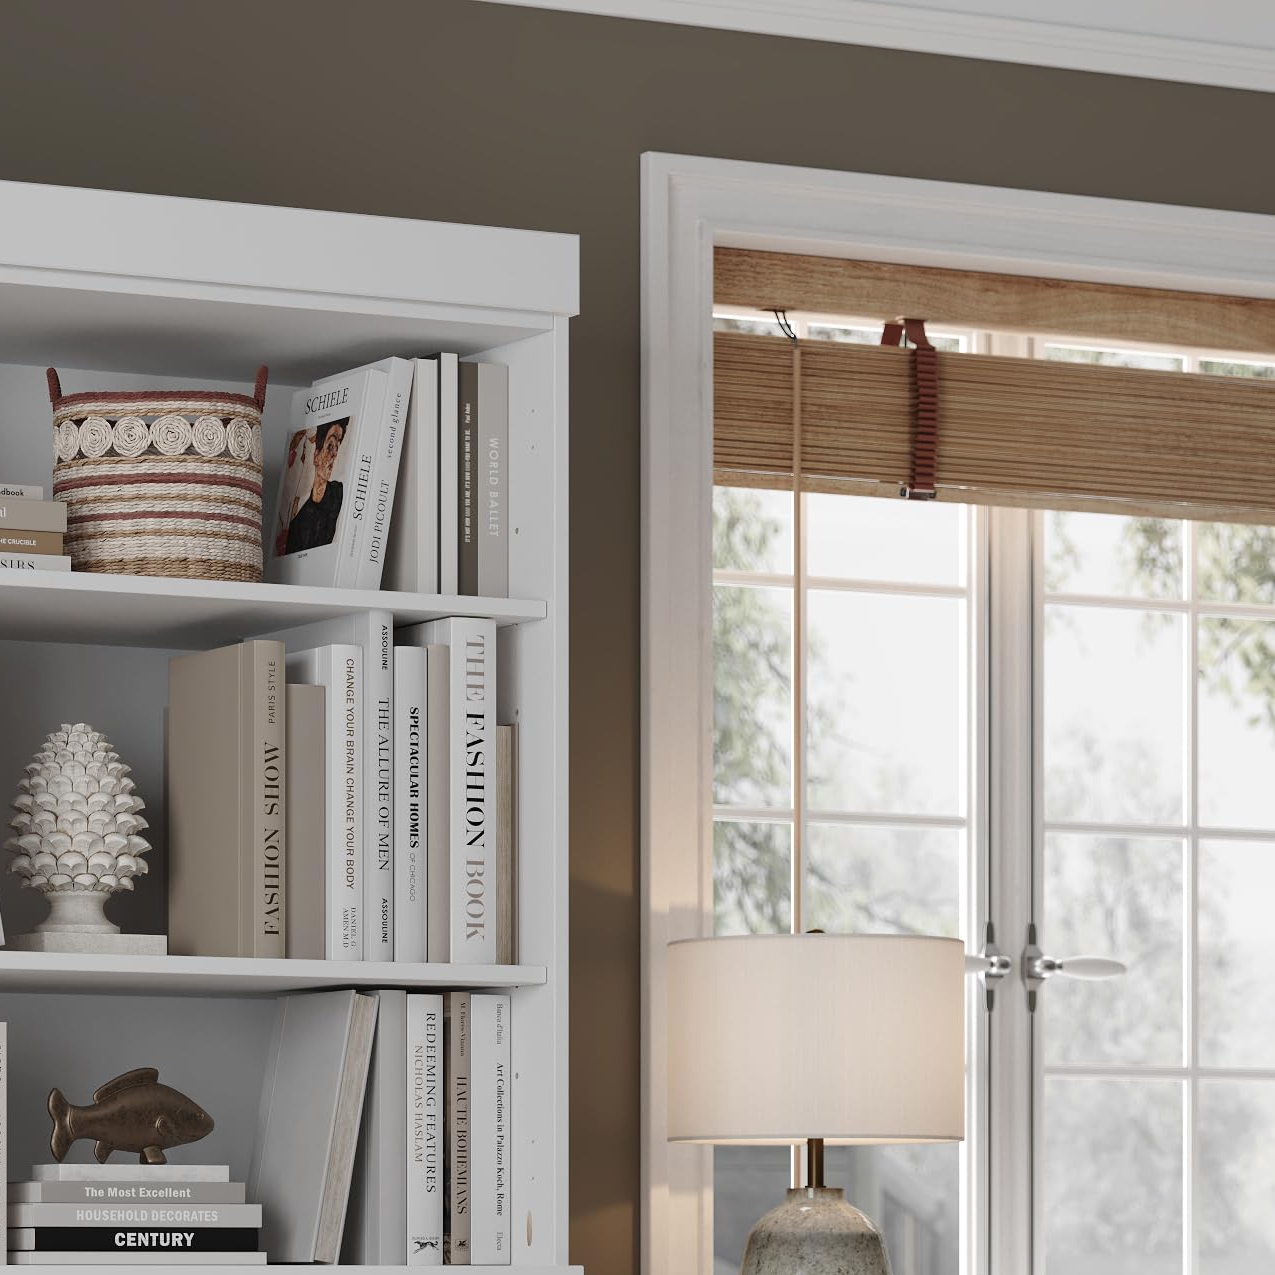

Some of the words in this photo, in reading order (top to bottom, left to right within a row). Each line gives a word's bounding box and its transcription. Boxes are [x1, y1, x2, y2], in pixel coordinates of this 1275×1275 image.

[305, 388, 349, 414] SCHIELE
[353, 455, 372, 520] SCHIELE
[374, 480, 389, 533] PICOULT
[370, 536, 379, 563] JODI
[346, 658, 354, 704] CHANGE
[466, 634, 485, 702] THE
[346, 707, 354, 737] YOUR
[378, 697, 389, 730] THE
[346, 741, 354, 773] BRAIN
[378, 735, 389, 802] ALLURE
[410, 707, 419, 798] SPECTACULAR
[264, 742, 280, 816] SHOW
[466, 712, 485, 848] FASHION
[346, 778, 354, 824] CHANGE
[378, 807, 389, 829] OF
[346, 826, 354, 857] YOUR
[410, 803, 419, 848] HOMES
[378, 833, 389, 871] MEN
[264, 828, 280, 936] FASHION
[346, 859, 354, 889] BODY
[466, 859, 485, 941] BOOK
[426, 1013, 436, 1107] REDEEMING
[496, 1062, 504, 1076] Art
[457, 1076, 467, 1125] HAUTE
[496, 1079, 504, 1122] Collections
[497, 1124, 504, 1132] in
[426, 1114, 436, 1193] FEATURES
[457, 1129, 467, 1214] BOHEMIANS
[496, 1135, 504, 1165] Palazzo
[85, 1187, 104, 1197] The
[108, 1187, 135, 1198] Most
[139, 1188, 191, 1198] Excellent
[495, 1168, 504, 1190] Koch,
[76, 1210, 148, 1221] HOUSEHOLD
[151, 1210, 218, 1222] DECORATES
[114, 1232, 195, 1247] CENTURY
